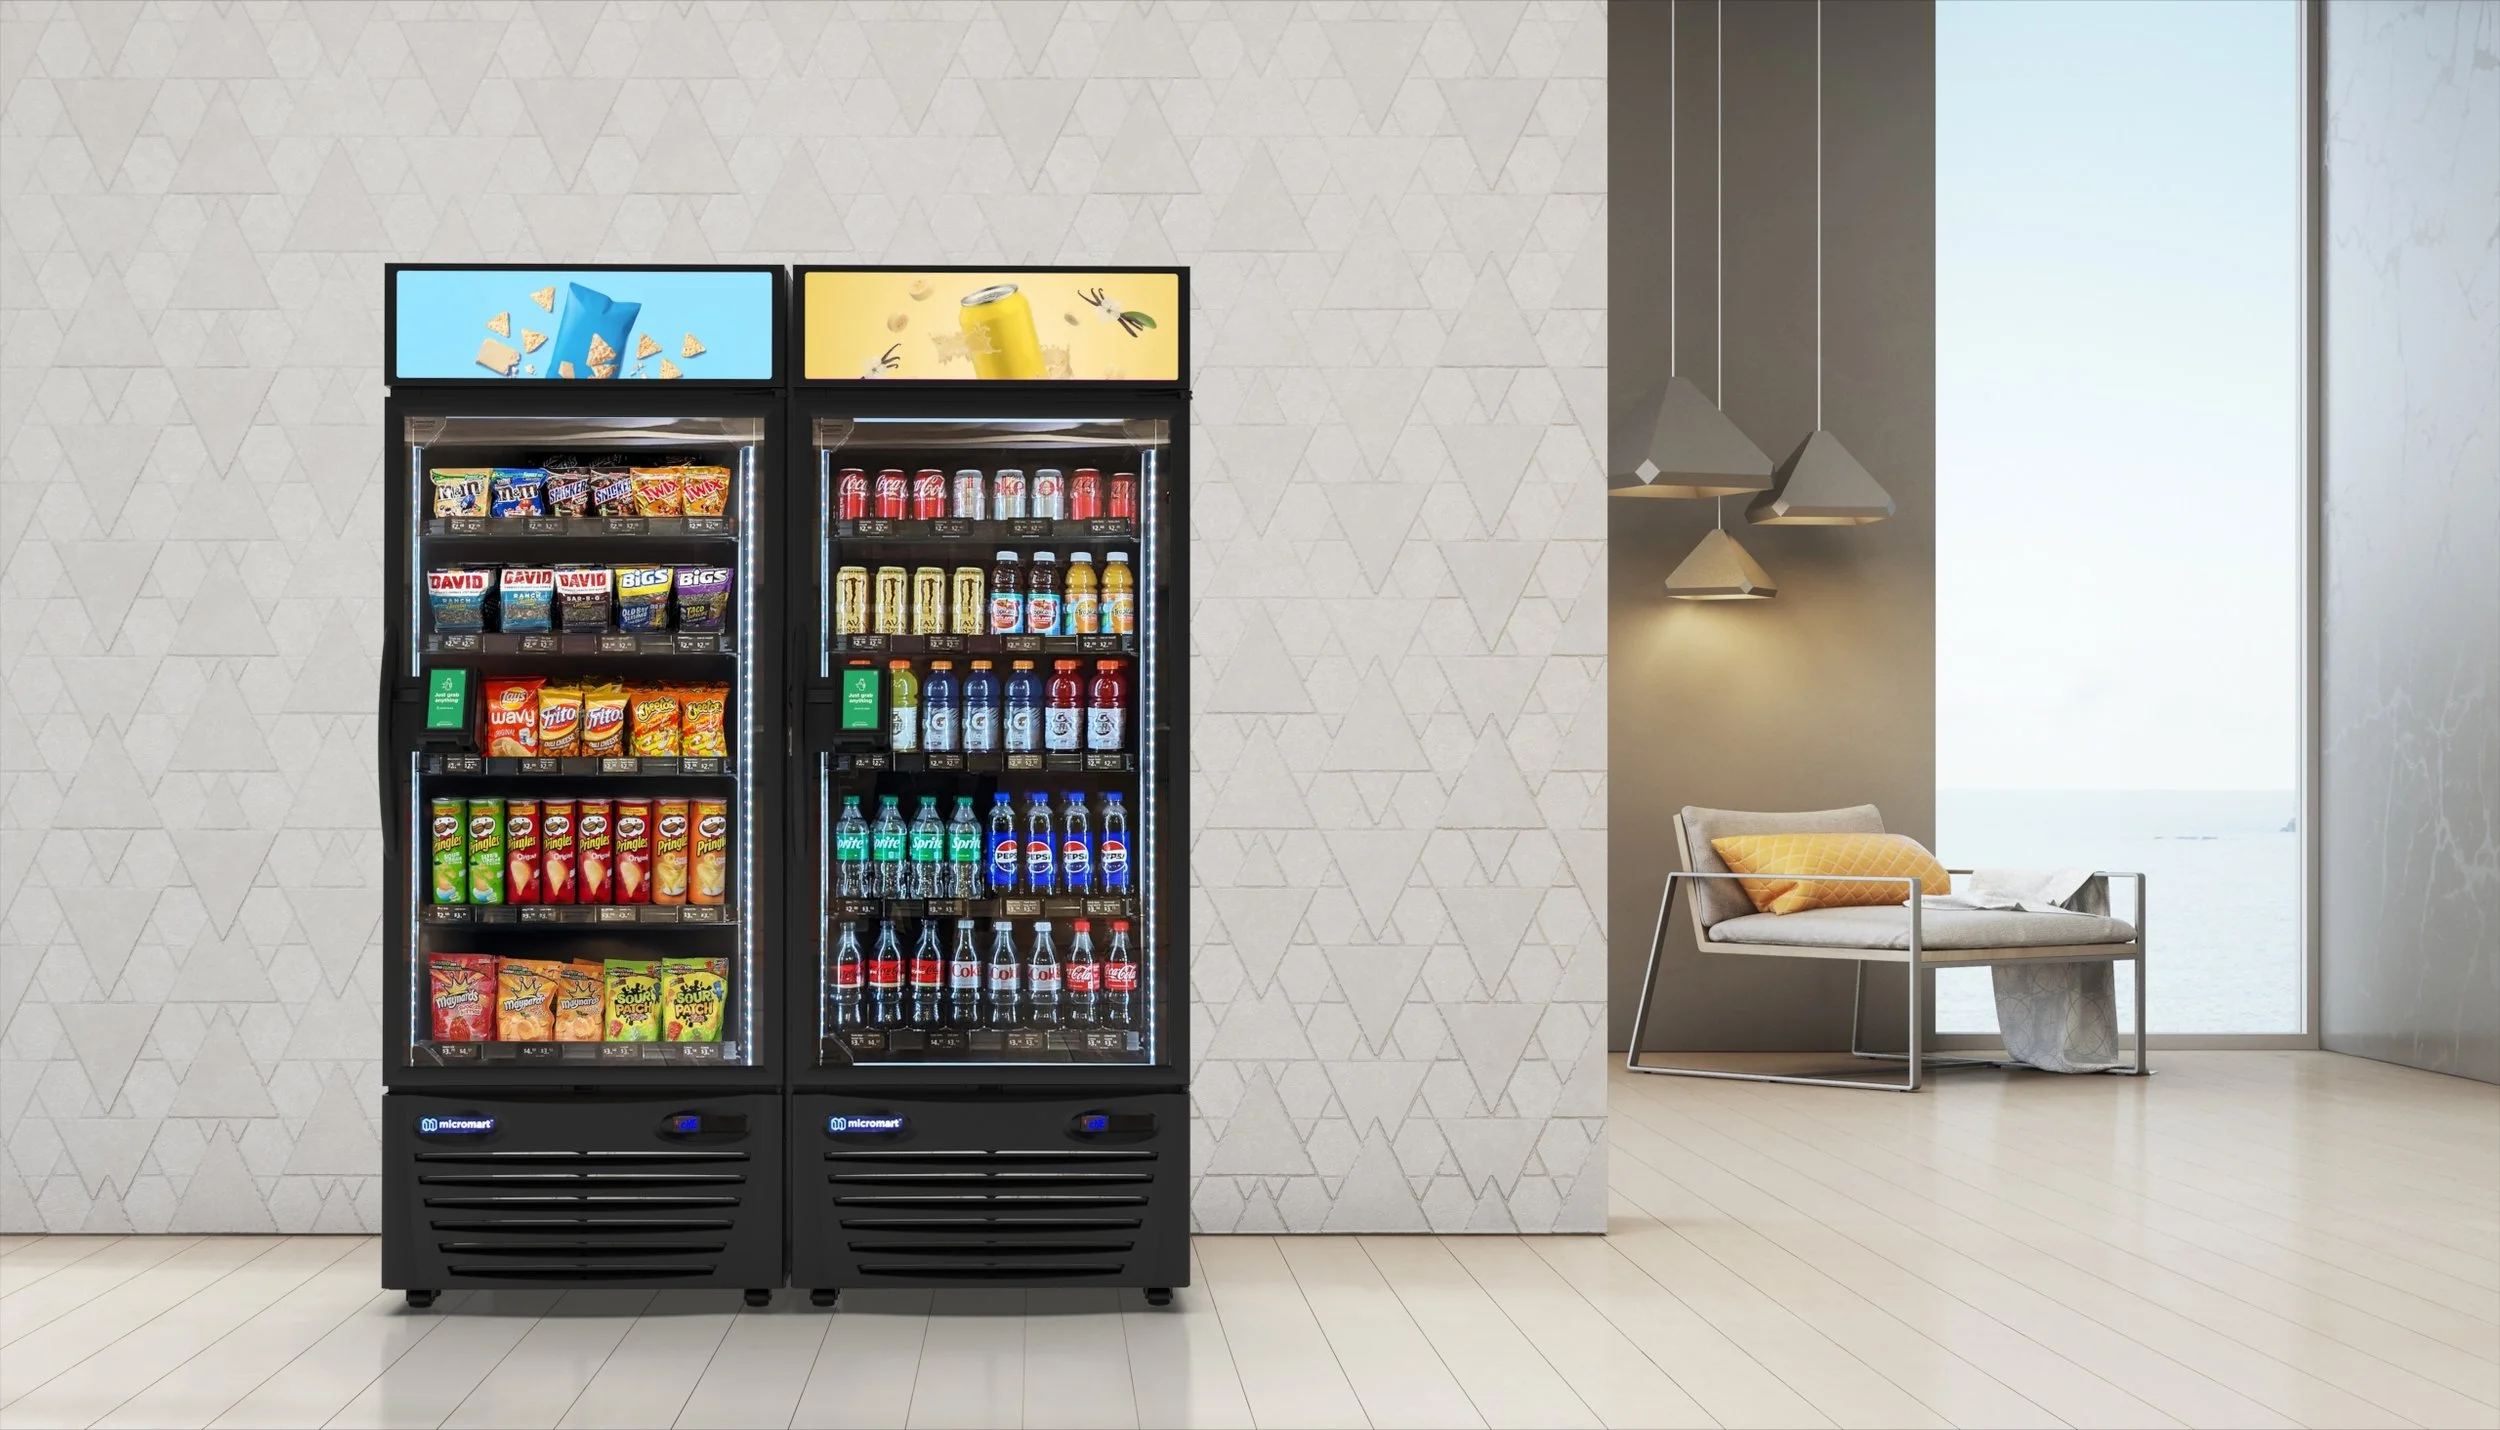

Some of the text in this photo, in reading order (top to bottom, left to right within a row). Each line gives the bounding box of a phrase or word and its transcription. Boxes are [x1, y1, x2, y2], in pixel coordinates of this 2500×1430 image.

[430, 575, 483, 589] DAVID
[560, 573, 606, 587] DAVID
[622, 607, 635, 617] OLD
[687, 605, 705, 616] TACO
[540, 705, 577, 729] Frito
[636, 698, 675, 722] Cheetos
[686, 700, 723, 722] Cheetos
[491, 709, 535, 727] wavy
[579, 833, 610, 853] Pringles
[616, 836, 648, 854] Pringles
[697, 834, 727, 856] Pringl
[838, 836, 864, 850] prite
[874, 836, 901, 850] prite
[952, 836, 981, 850] Sprit
[996, 850, 1017, 860] PEPS
[617, 993, 651, 1004] SOUR
[677, 992, 712, 1004] SOUR
[615, 1003, 653, 1017] PATCH
[674, 1004, 714, 1017] PATCH
[439, 1119, 491, 1129] micromart
[848, 1118, 900, 1128] micromart
